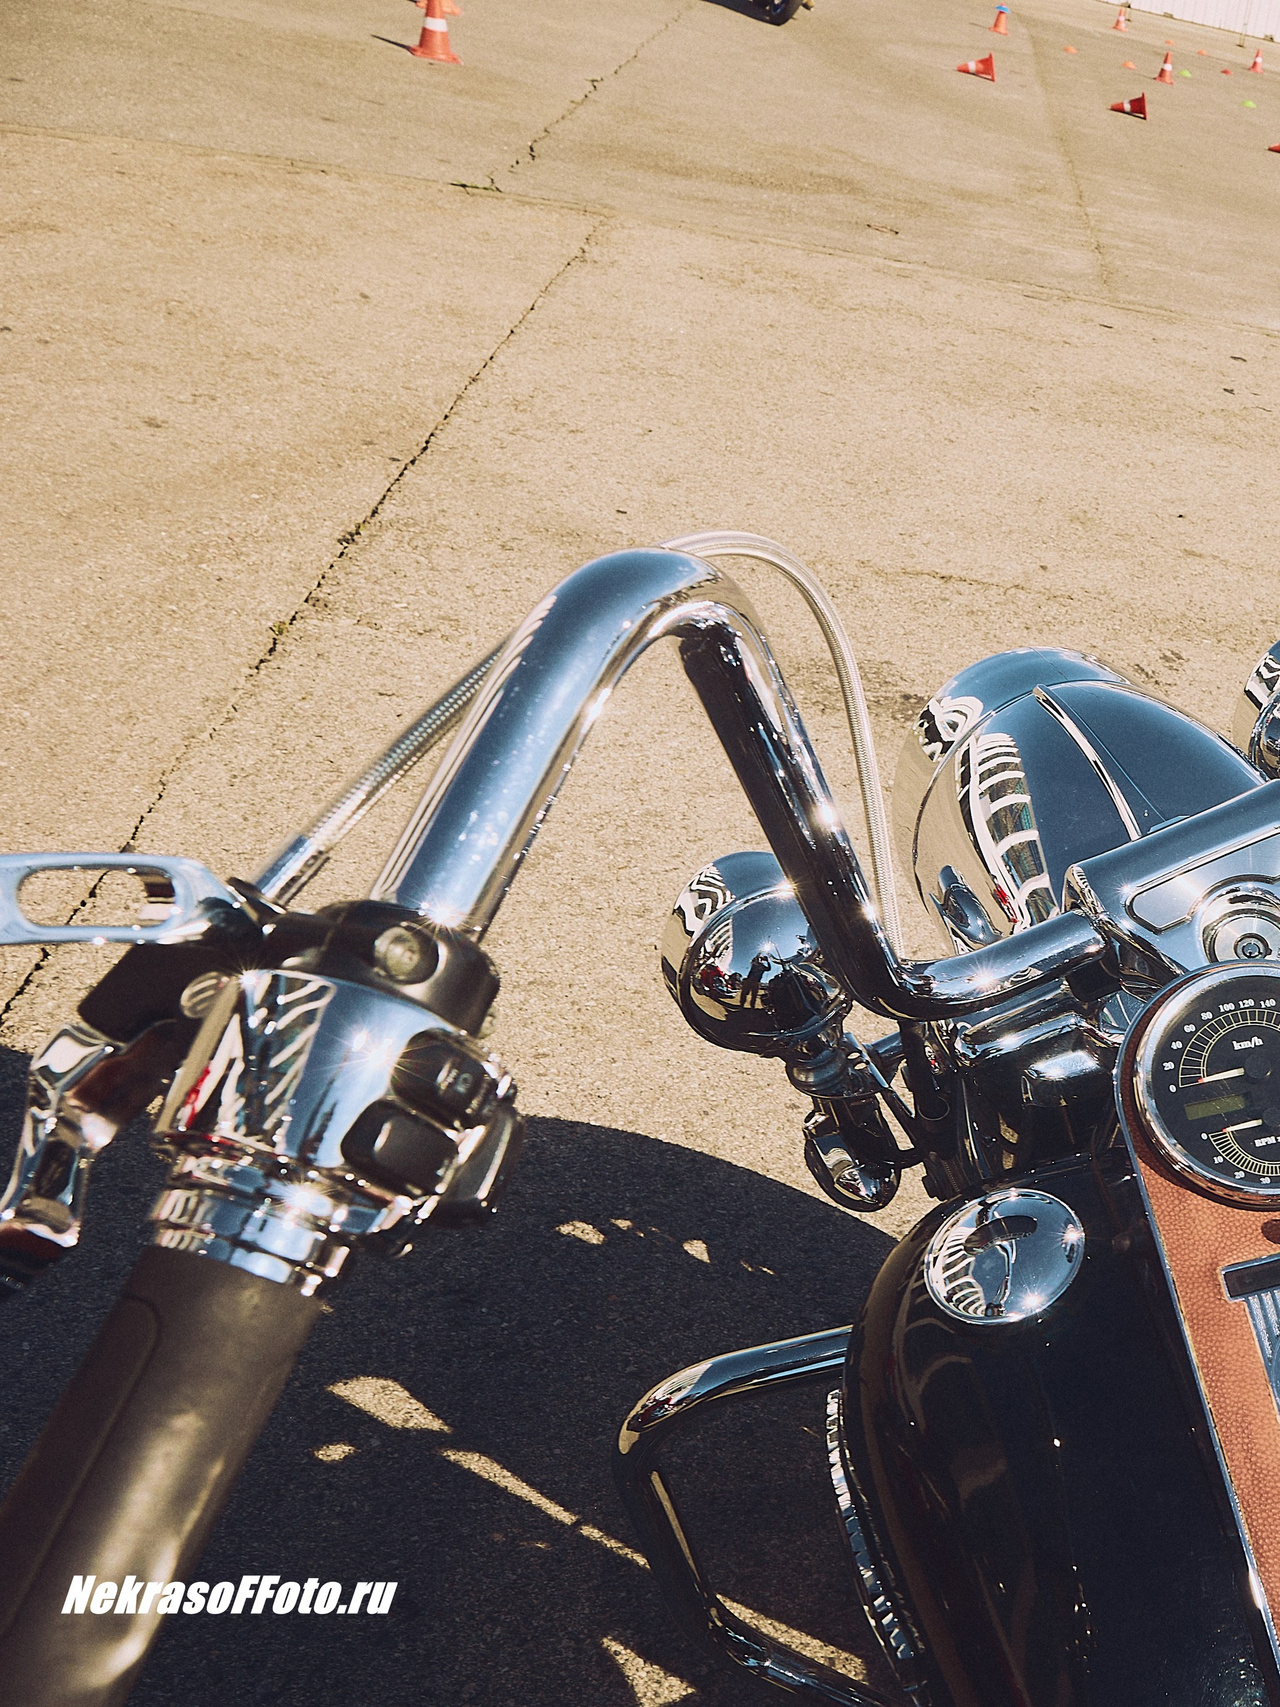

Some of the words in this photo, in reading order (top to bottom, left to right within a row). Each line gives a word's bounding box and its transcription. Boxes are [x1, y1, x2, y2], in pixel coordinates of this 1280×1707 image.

[1218, 1003, 1235, 1012] 100
[1238, 999, 1254, 1008] 120
[1260, 998, 1276, 1008] 140
[1200, 1012, 1212, 1020] 80
[1184, 1024, 1196, 1032] 60
[1170, 1040, 1182, 1050] 40
[1232, 1036, 1264, 1050] km/h
[1162, 1062, 1174, 1070] 20
[1254, 1136, 1276, 1147] RPM
[1213, 1156, 1224, 1164] 10
[1234, 1170, 1245, 1178] 20
